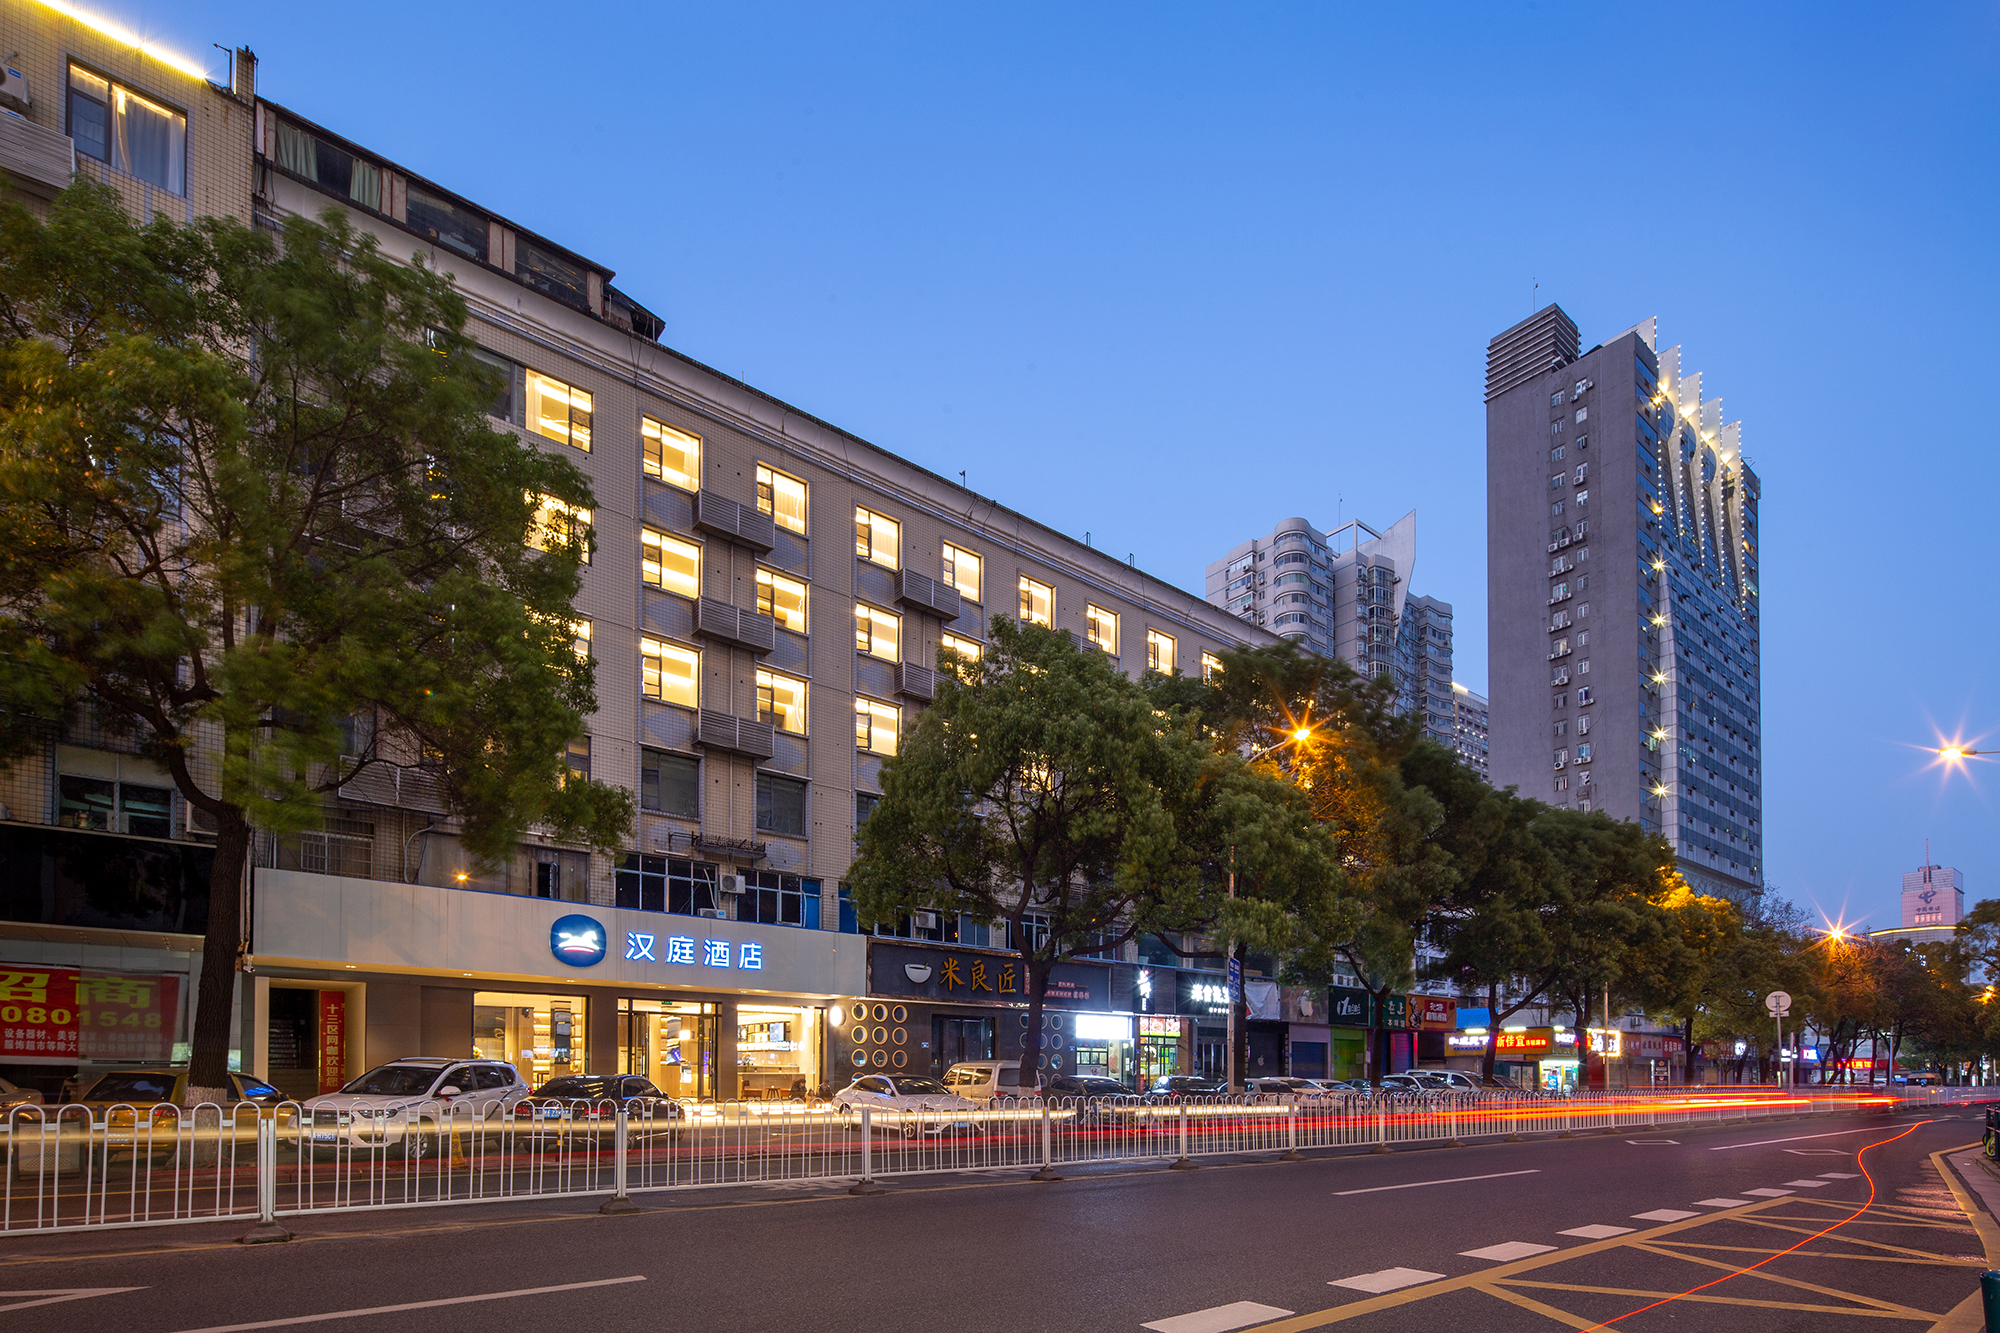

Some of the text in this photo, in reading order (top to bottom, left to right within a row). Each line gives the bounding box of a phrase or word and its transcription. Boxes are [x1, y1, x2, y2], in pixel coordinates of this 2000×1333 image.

[625, 931, 763, 970] 汉庭酒店
[939, 957, 1017, 994] 米良匠
[326, 1004, 339, 1087] 十三区网咖欢迎您
[1496, 1034, 1525, 1048] 新佳宜
